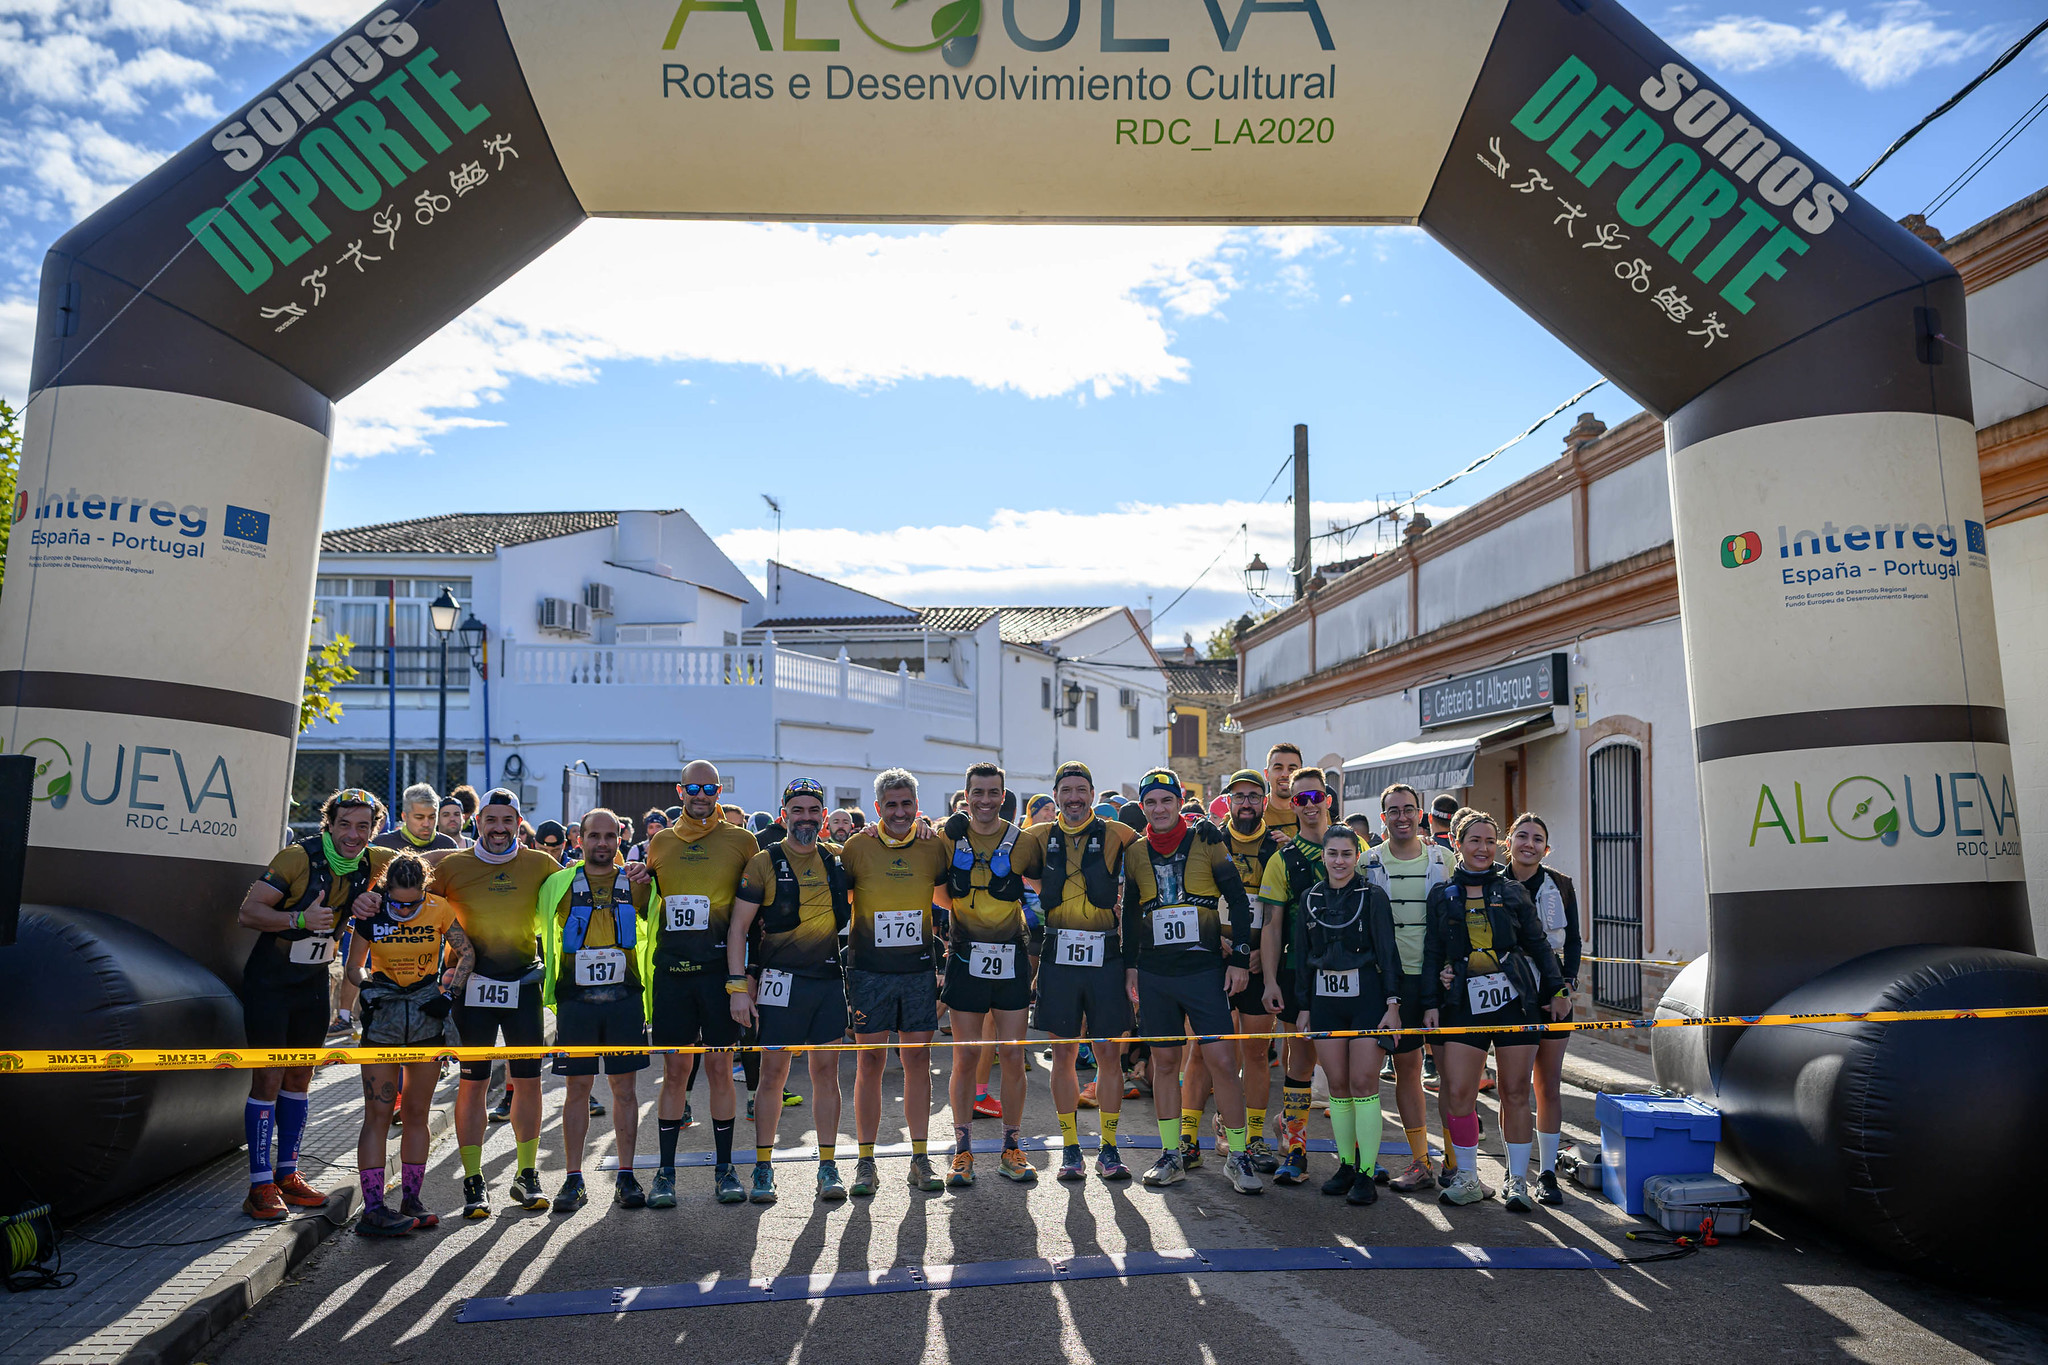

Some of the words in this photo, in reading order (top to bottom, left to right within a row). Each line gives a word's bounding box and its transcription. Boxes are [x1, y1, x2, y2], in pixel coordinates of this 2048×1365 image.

[662, 64, 774, 99] Rotas
[788, 73, 811, 99] e
[826, 64, 1171, 101] Desenvolvimiento
[1186, 63, 1337, 100] Cultural
[1115, 117, 1335, 151] RDC_LA2020
[185, 46, 492, 295] DEPORTE
[1510, 54, 1811, 315] DEPORTE
[34, 487, 209, 538] Interreg
[30, 528, 91, 547] España
[112, 531, 205, 559] Portugal
[1778, 521, 1958, 557] Interreg
[103, 557, 132, 565] Regional
[125, 565, 155, 575] Regional
[1782, 562, 1862, 586] España
[1884, 560, 1961, 580] Portugal
[1806, 592, 1834, 600] Europeo
[1807, 598, 1835, 606] Europeu
[1434, 681, 1473, 718] Cafetería
[1475, 678, 1485, 709] El
[1486, 674, 1533, 709] Albergue
[126, 813, 238, 838] RDC_LA2020
[674, 908, 695, 928] 59
[373, 923, 435, 936] bichos
[374, 934, 435, 944] runners
[882, 922, 916, 939] 176
[1163, 920, 1186, 941] 30
[309, 942, 327, 960] 71
[1066, 943, 1094, 963] 151
[586, 962, 616, 982] 137
[981, 956, 1002, 976] 29
[477, 984, 509, 1003] 145
[1322, 974, 1350, 993] 184
[1478, 986, 1513, 1009] 204
[1574, 1021, 1623, 1030] FEXME
